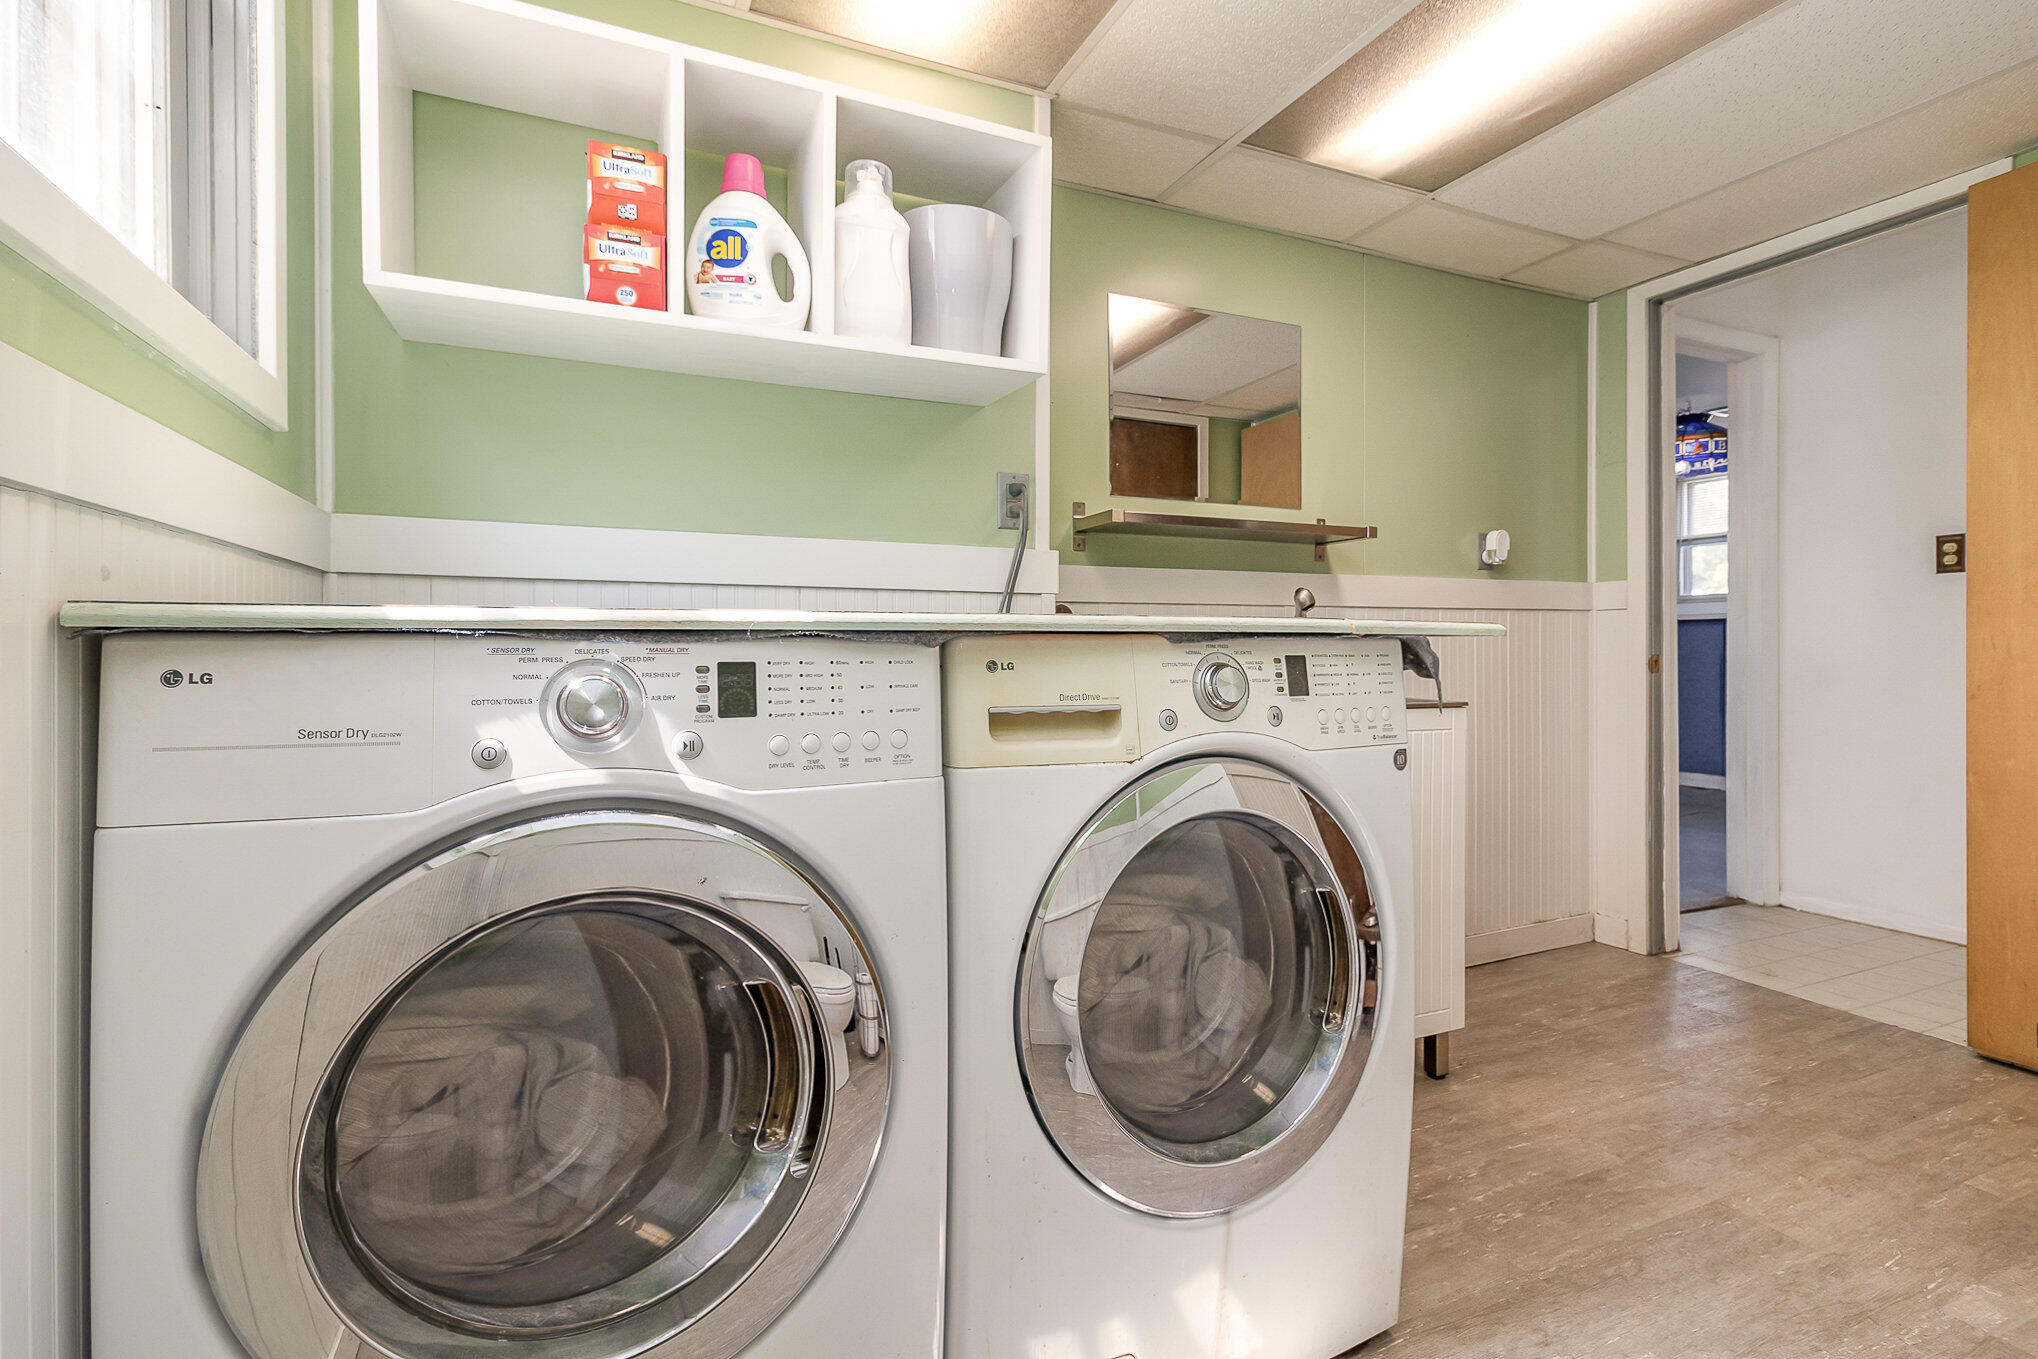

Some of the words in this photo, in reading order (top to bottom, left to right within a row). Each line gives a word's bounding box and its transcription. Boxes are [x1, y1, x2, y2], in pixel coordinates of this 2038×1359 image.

[710, 236, 743, 260] all
[1000, 662, 1015, 671] LG
[188, 672, 214, 685] LG
[297, 728, 343, 740] Sensor
[346, 727, 370, 741] Dry
